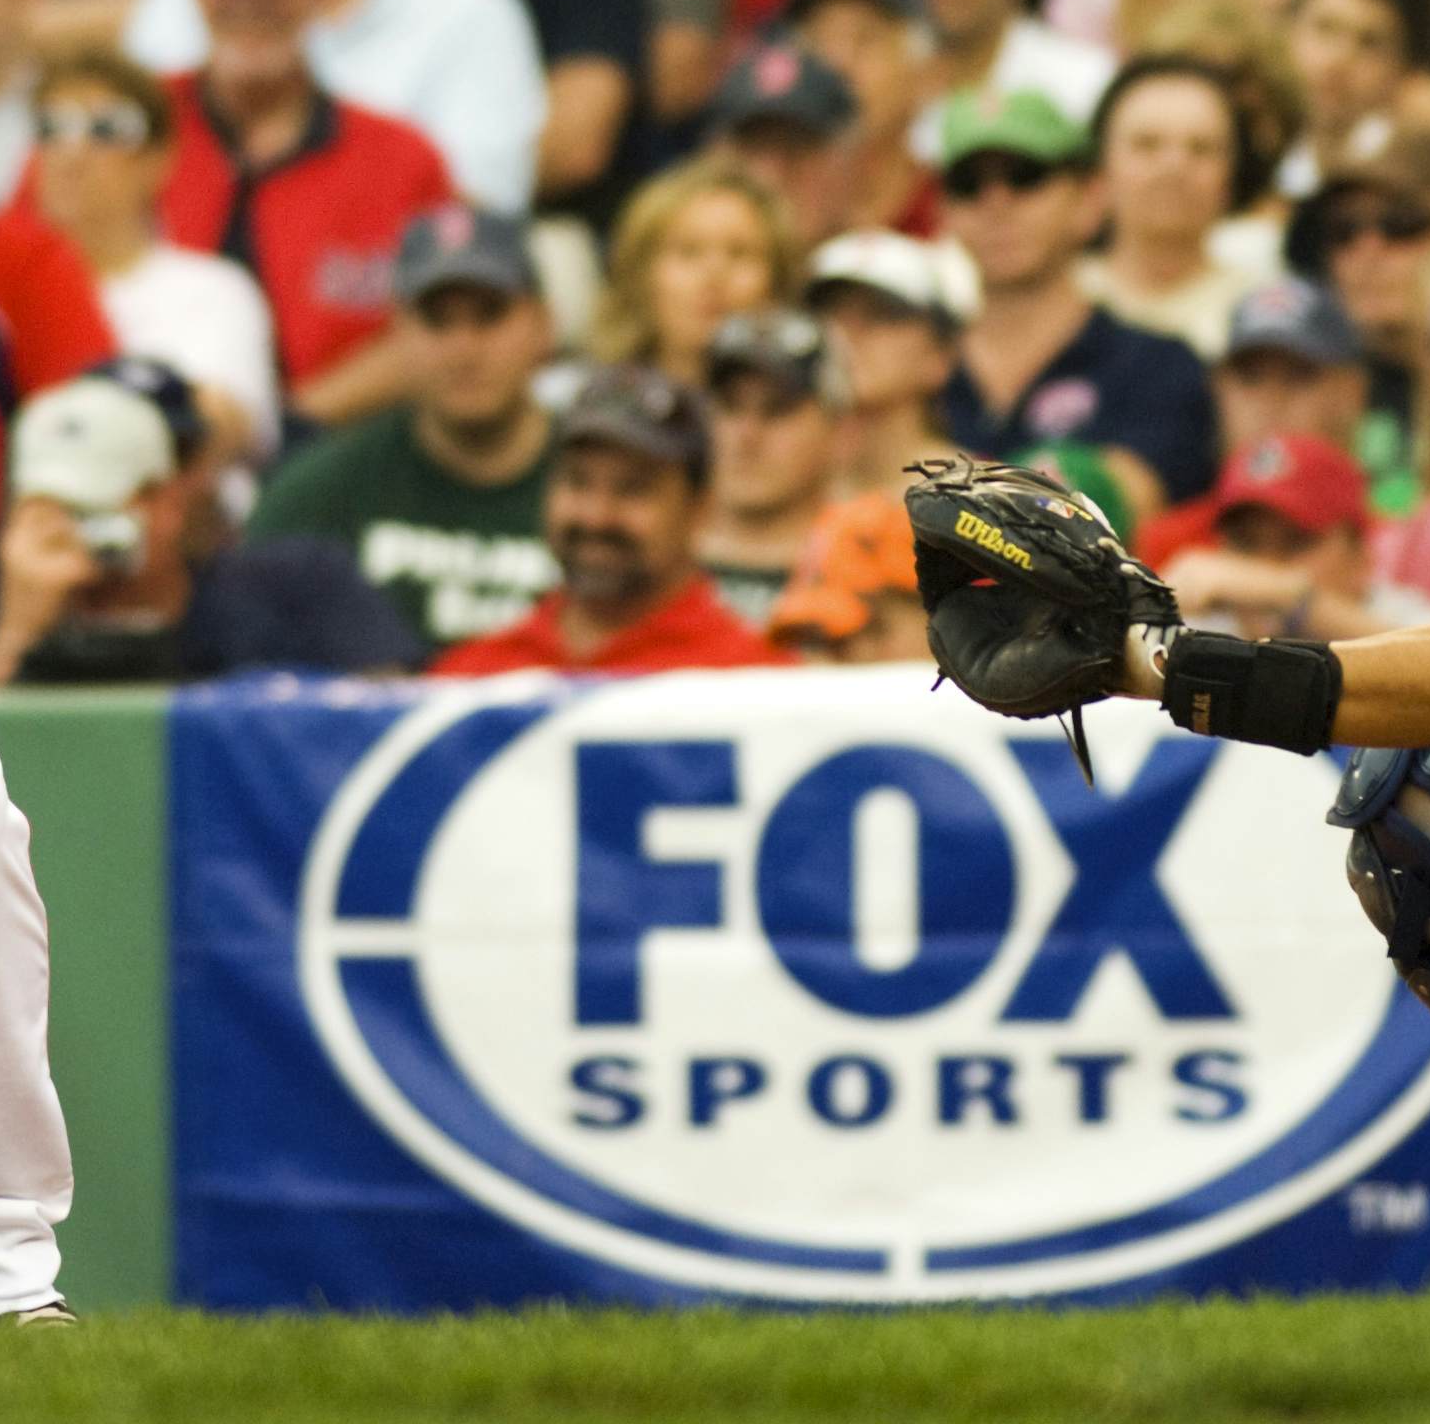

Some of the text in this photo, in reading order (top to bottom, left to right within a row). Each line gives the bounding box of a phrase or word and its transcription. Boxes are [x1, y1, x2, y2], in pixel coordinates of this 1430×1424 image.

[955, 510, 1034, 571] Wilson
[571, 734, 1243, 1029] FOX
[569, 1051, 1252, 1129] SPORTS
